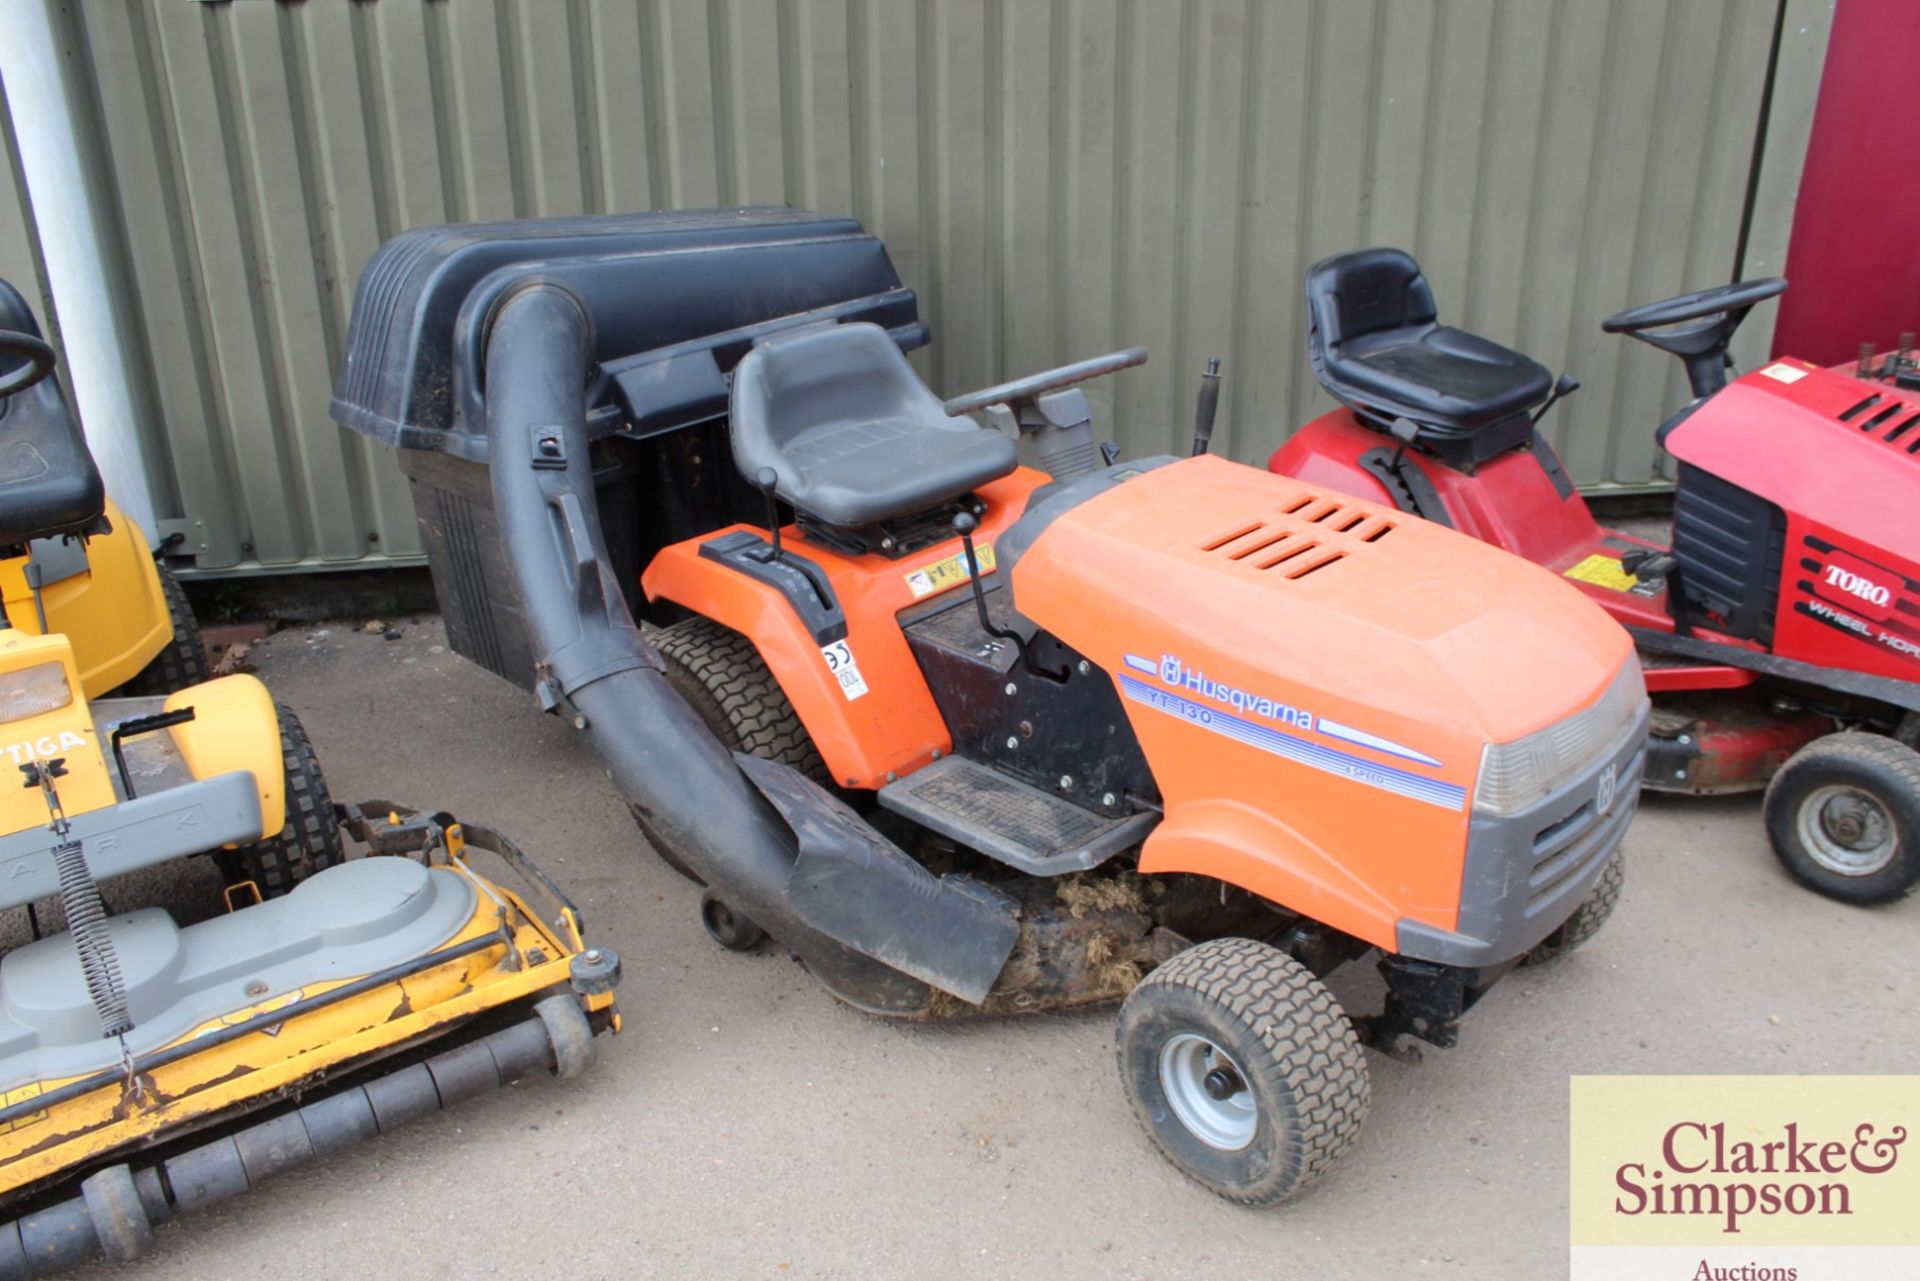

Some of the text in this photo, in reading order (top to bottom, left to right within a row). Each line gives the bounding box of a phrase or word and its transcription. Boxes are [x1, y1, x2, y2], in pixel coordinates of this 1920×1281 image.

[1825, 565, 1890, 605] TORO
[1809, 601, 1920, 659] WHEEL HOR
[1148, 690, 1212, 724] YT 130
[1185, 668, 1314, 731] Husqvarna
[0, 731, 87, 764] TIGA
[1353, 767, 1385, 783] SPEED
